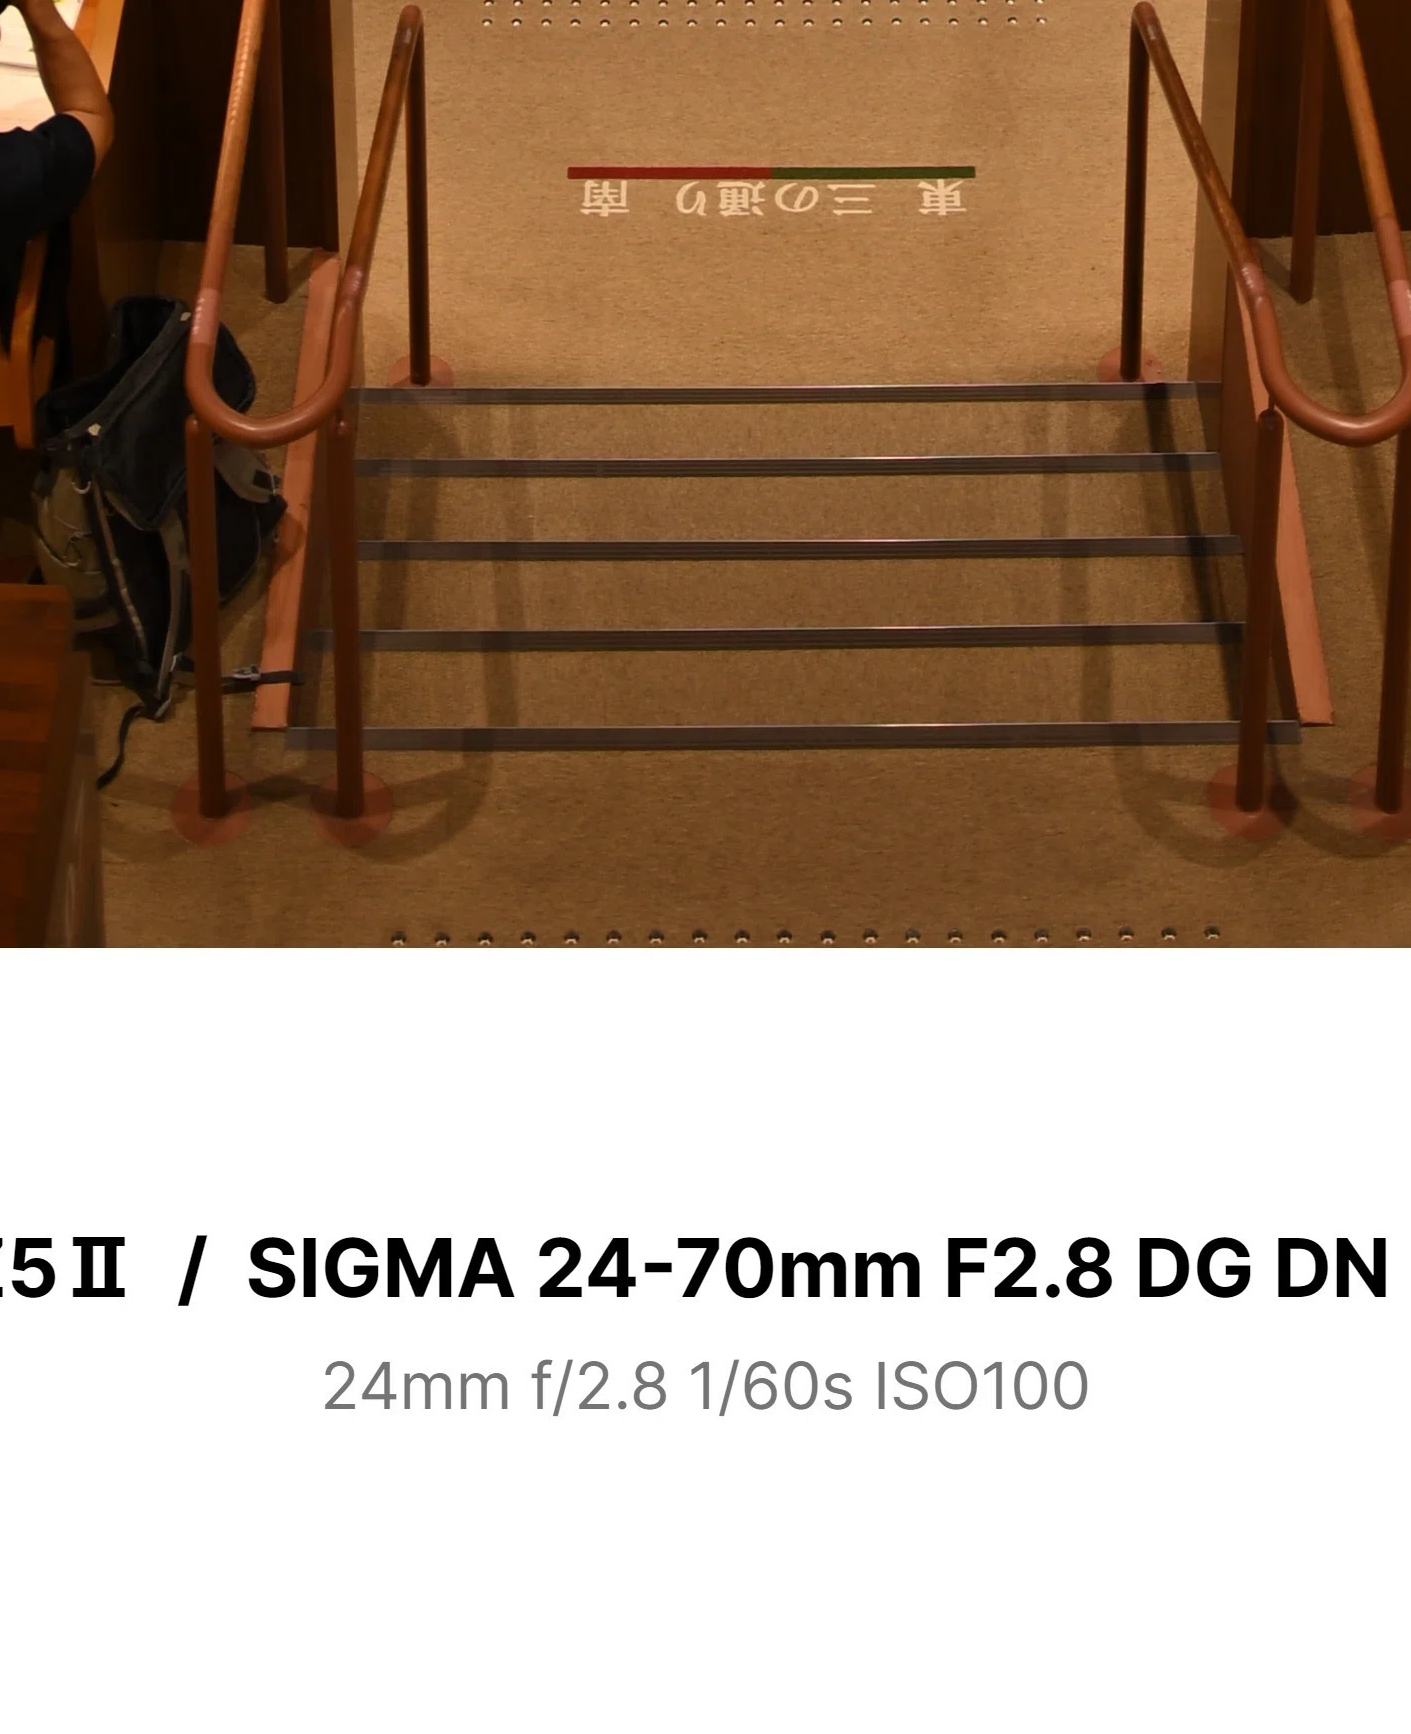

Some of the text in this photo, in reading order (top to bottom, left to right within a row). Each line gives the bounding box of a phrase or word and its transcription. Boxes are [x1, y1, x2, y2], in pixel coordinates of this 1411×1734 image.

[581, 179, 968, 217] 東 三の通り 南
